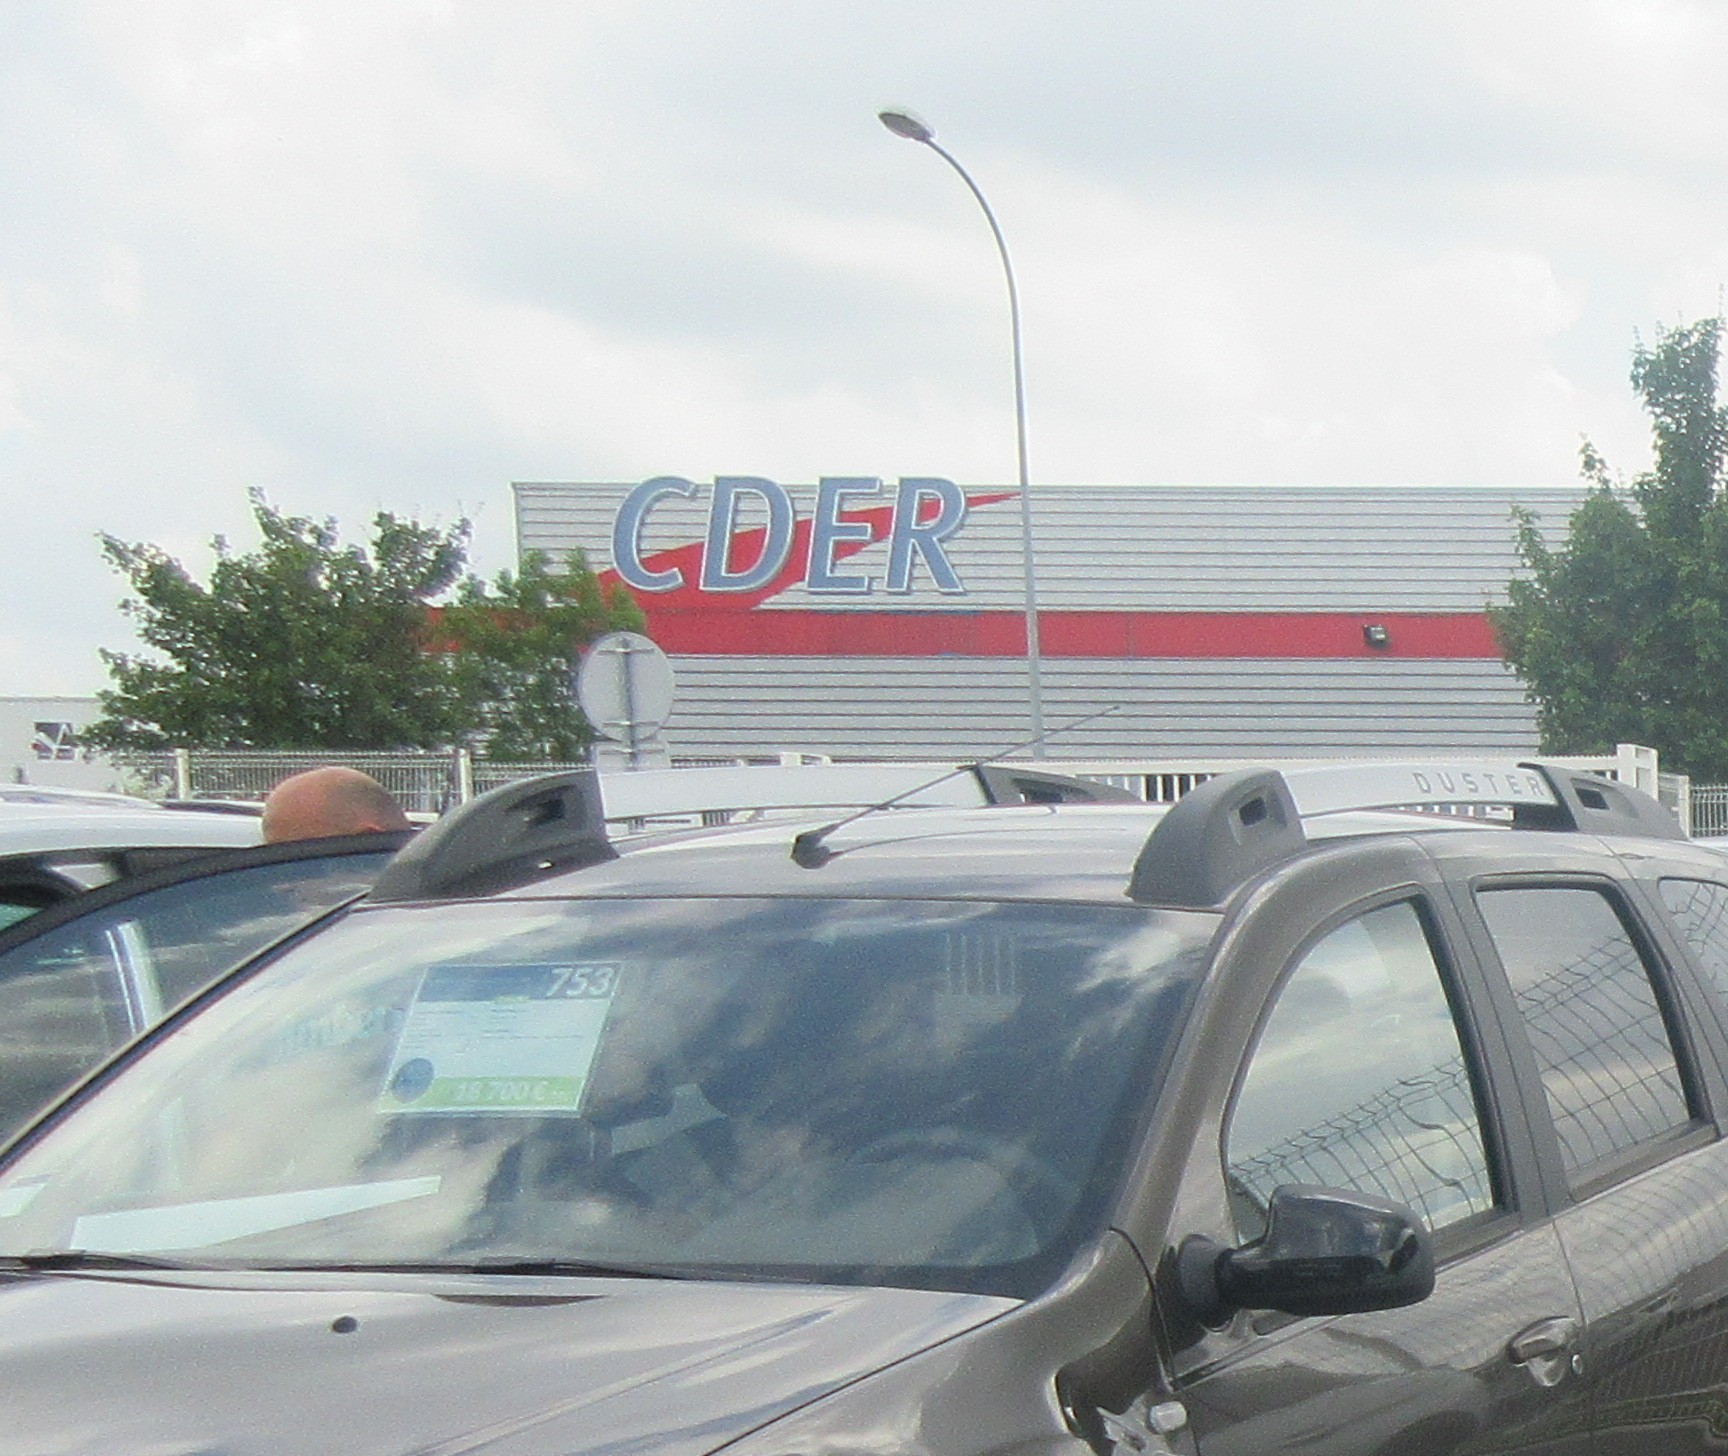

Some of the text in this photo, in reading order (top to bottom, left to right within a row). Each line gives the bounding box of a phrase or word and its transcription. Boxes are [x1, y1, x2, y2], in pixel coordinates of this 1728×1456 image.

[611, 475, 966, 594] CDER
[1412, 771, 1544, 797] DUSTER
[546, 966, 614, 997] 753
